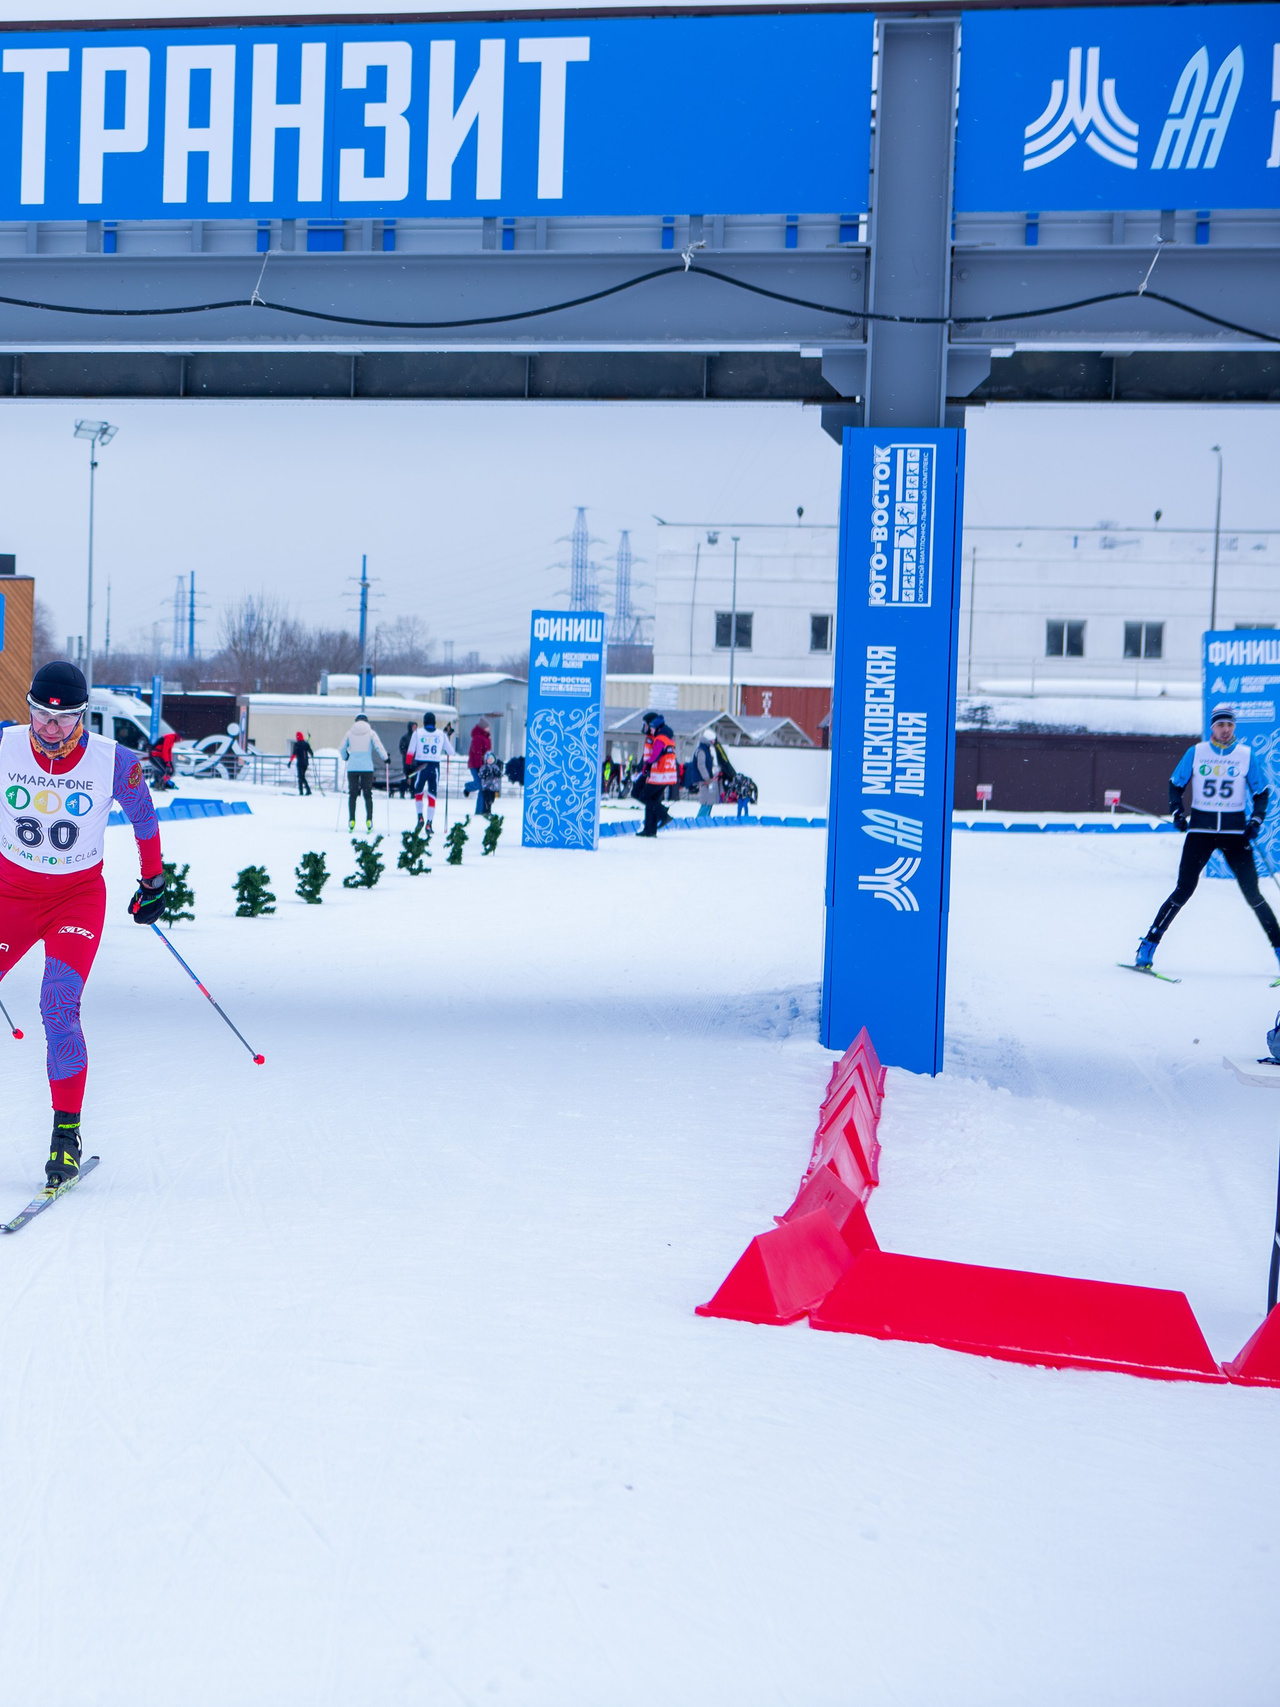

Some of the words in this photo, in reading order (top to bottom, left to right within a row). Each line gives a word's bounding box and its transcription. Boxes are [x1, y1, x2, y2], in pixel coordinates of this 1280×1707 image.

[2, 36, 591, 205] ТРАНЗИТ
[869, 445, 892, 606] ЮГО-ВОСТОК
[917, 565, 925, 603] ОКРУЖНОЙ
[533, 617, 602, 643] ФИНИШ
[861, 645, 897, 795] МОСКОВСКАЯ
[422, 744, 437, 755] 56
[894, 712, 928, 797] ЛЫЖНЯ
[8, 772, 94, 791] VMARAFONE
[1202, 778, 1235, 799] 55
[14, 816, 80, 852] 80
